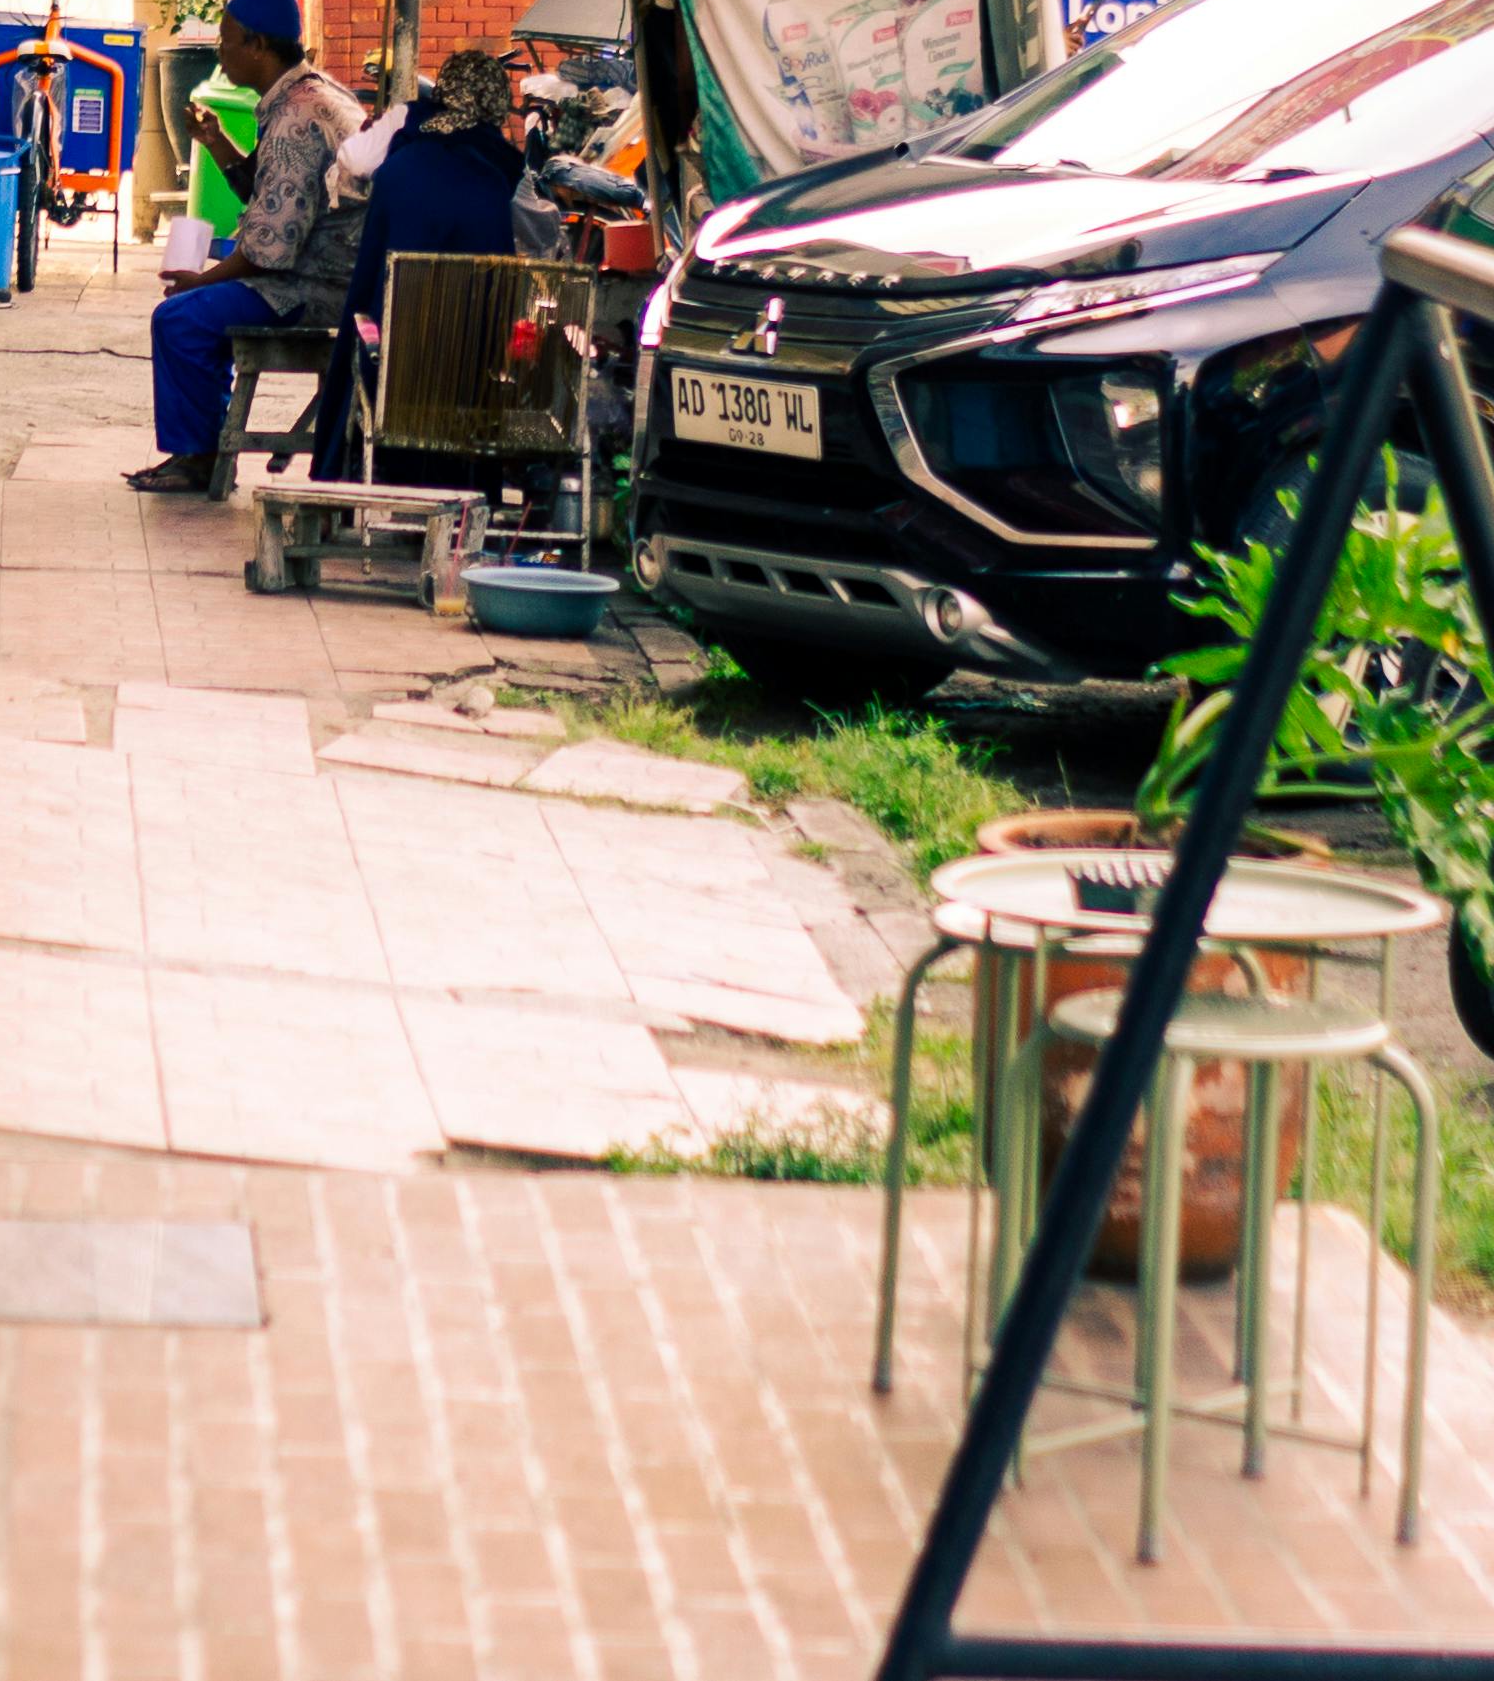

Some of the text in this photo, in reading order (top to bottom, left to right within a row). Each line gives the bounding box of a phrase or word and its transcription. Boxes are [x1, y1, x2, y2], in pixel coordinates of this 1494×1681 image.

[678, 377, 813, 434] AD 1380 WL
